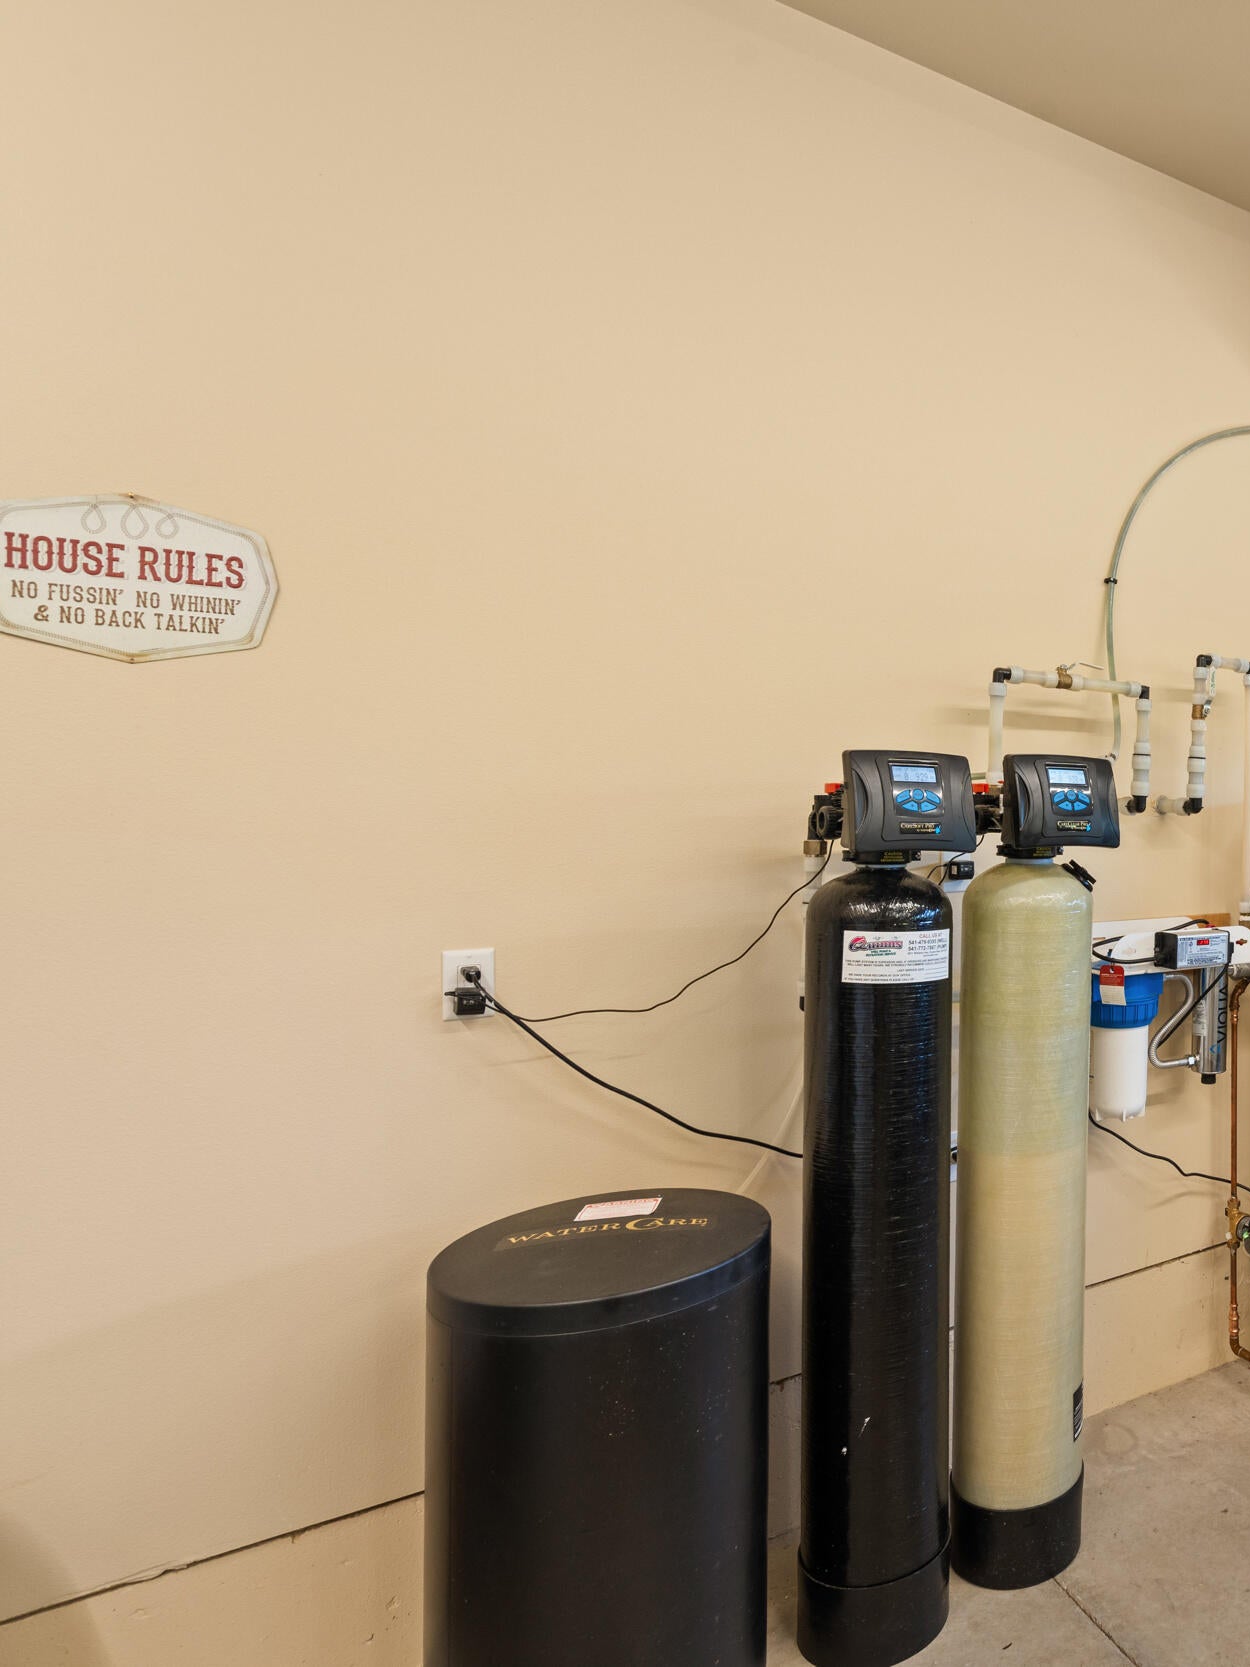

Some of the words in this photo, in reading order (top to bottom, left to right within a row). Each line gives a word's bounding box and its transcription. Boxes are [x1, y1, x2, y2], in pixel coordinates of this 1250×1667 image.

[4, 531, 126, 579] HOUSE
[137, 545, 246, 590] RULES
[11, 579, 38, 599] NO
[47, 582, 125, 606] FUSSIN'
[135, 590, 161, 609] NO
[170, 593, 242, 616] WHININ'
[33, 604, 50, 623] &
[58, 606, 86, 625] NO
[94, 608, 146, 629] BACK
[154, 612, 226, 635] TALKIN'
